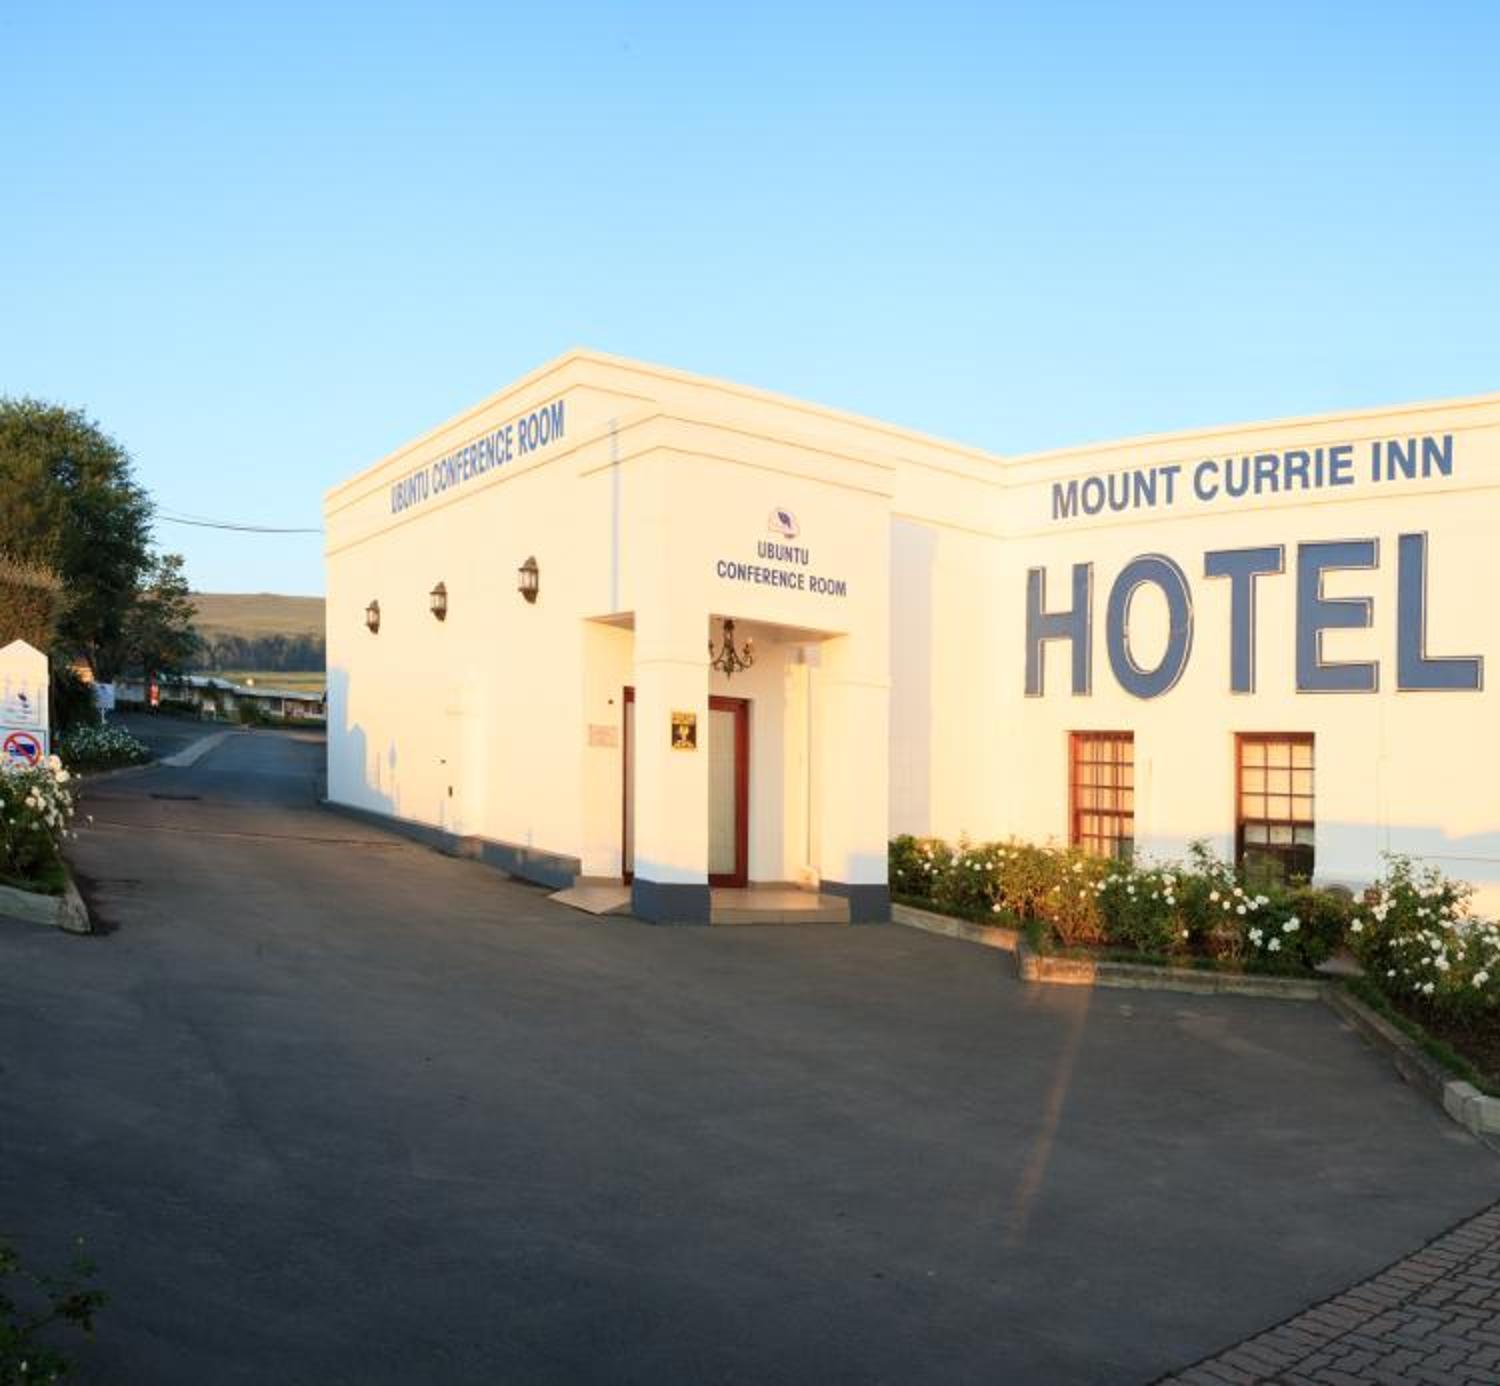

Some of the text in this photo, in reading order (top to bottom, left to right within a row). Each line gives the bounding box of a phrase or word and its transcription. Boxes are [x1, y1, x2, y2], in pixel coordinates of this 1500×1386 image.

[391, 400, 565, 514] UBUNTU CONFERENCE ROOM
[1051, 435, 1454, 520] MOUNT CURRIE INN
[717, 560, 847, 597] CONFERENCE ROOM
[757, 540, 809, 566] UBUNTU
[1024, 530, 1485, 700] HOTEL
